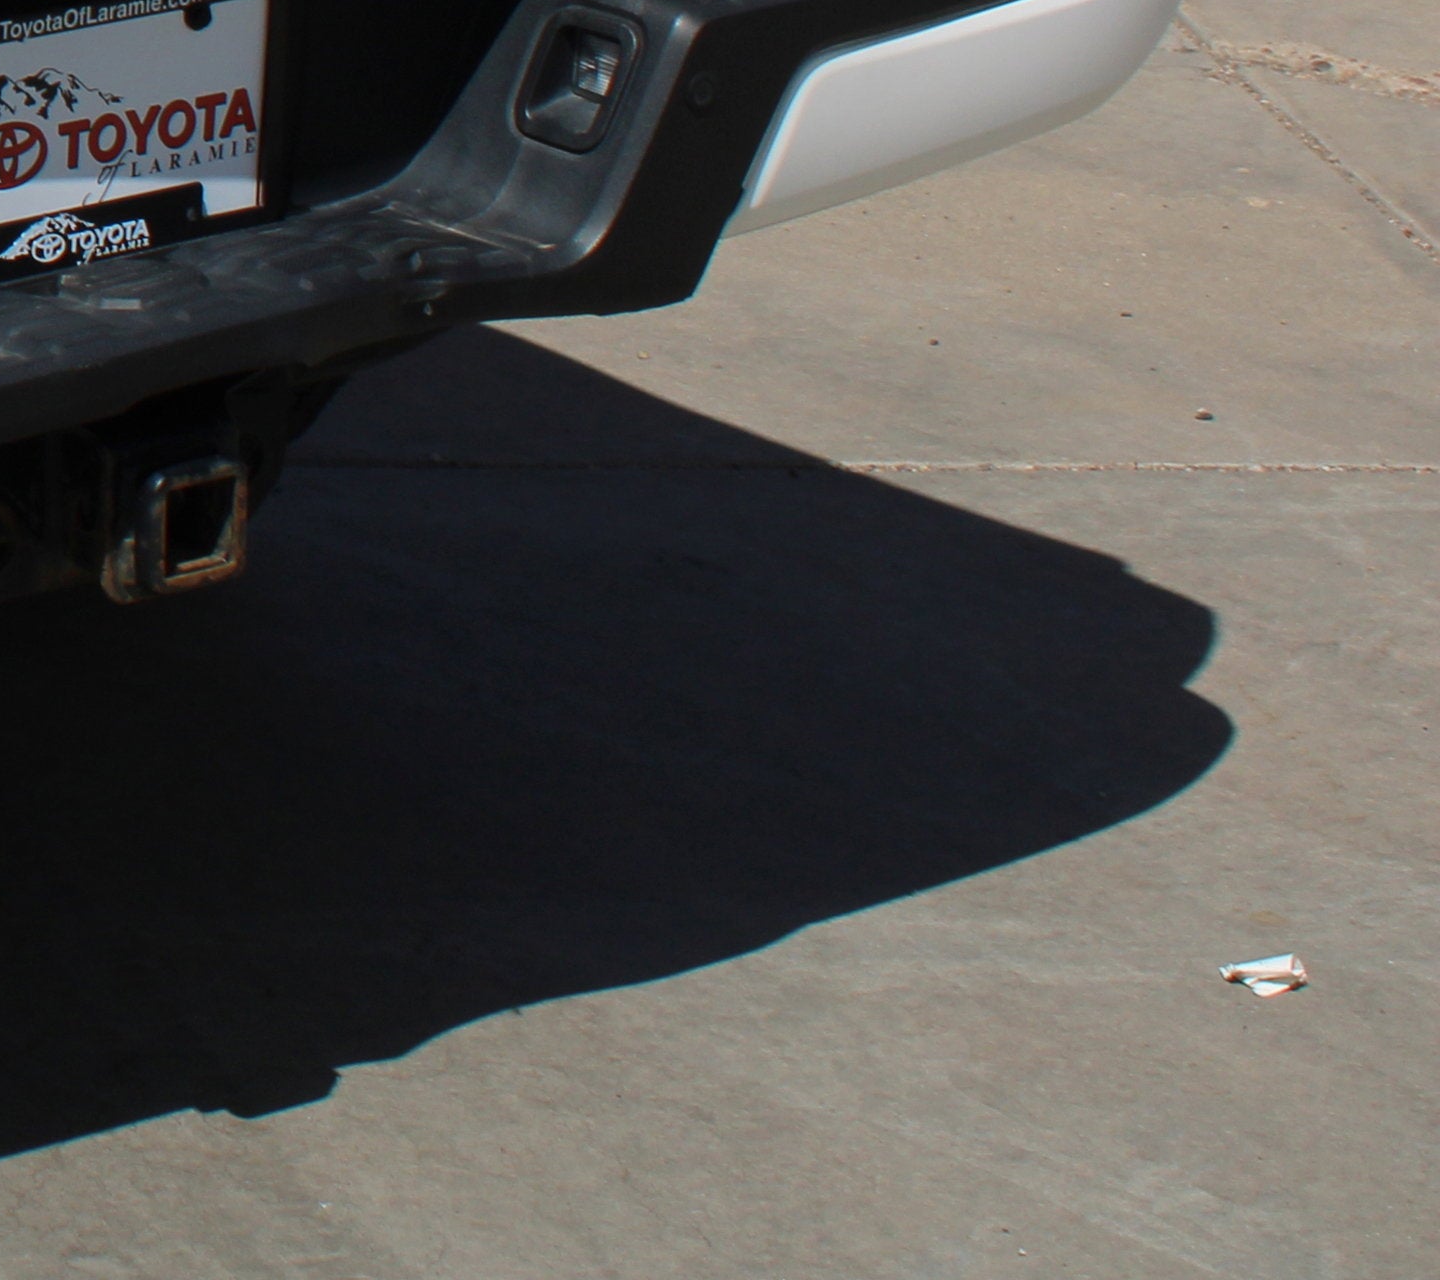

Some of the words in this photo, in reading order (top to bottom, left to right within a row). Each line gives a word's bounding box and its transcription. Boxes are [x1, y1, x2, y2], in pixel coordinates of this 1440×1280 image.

[58, 87, 257, 170] TOYOTA
[130, 137, 258, 178] LARAMIE
[67, 218, 150, 254] TOYOTA
[95, 238, 150, 257] LARAMIE
